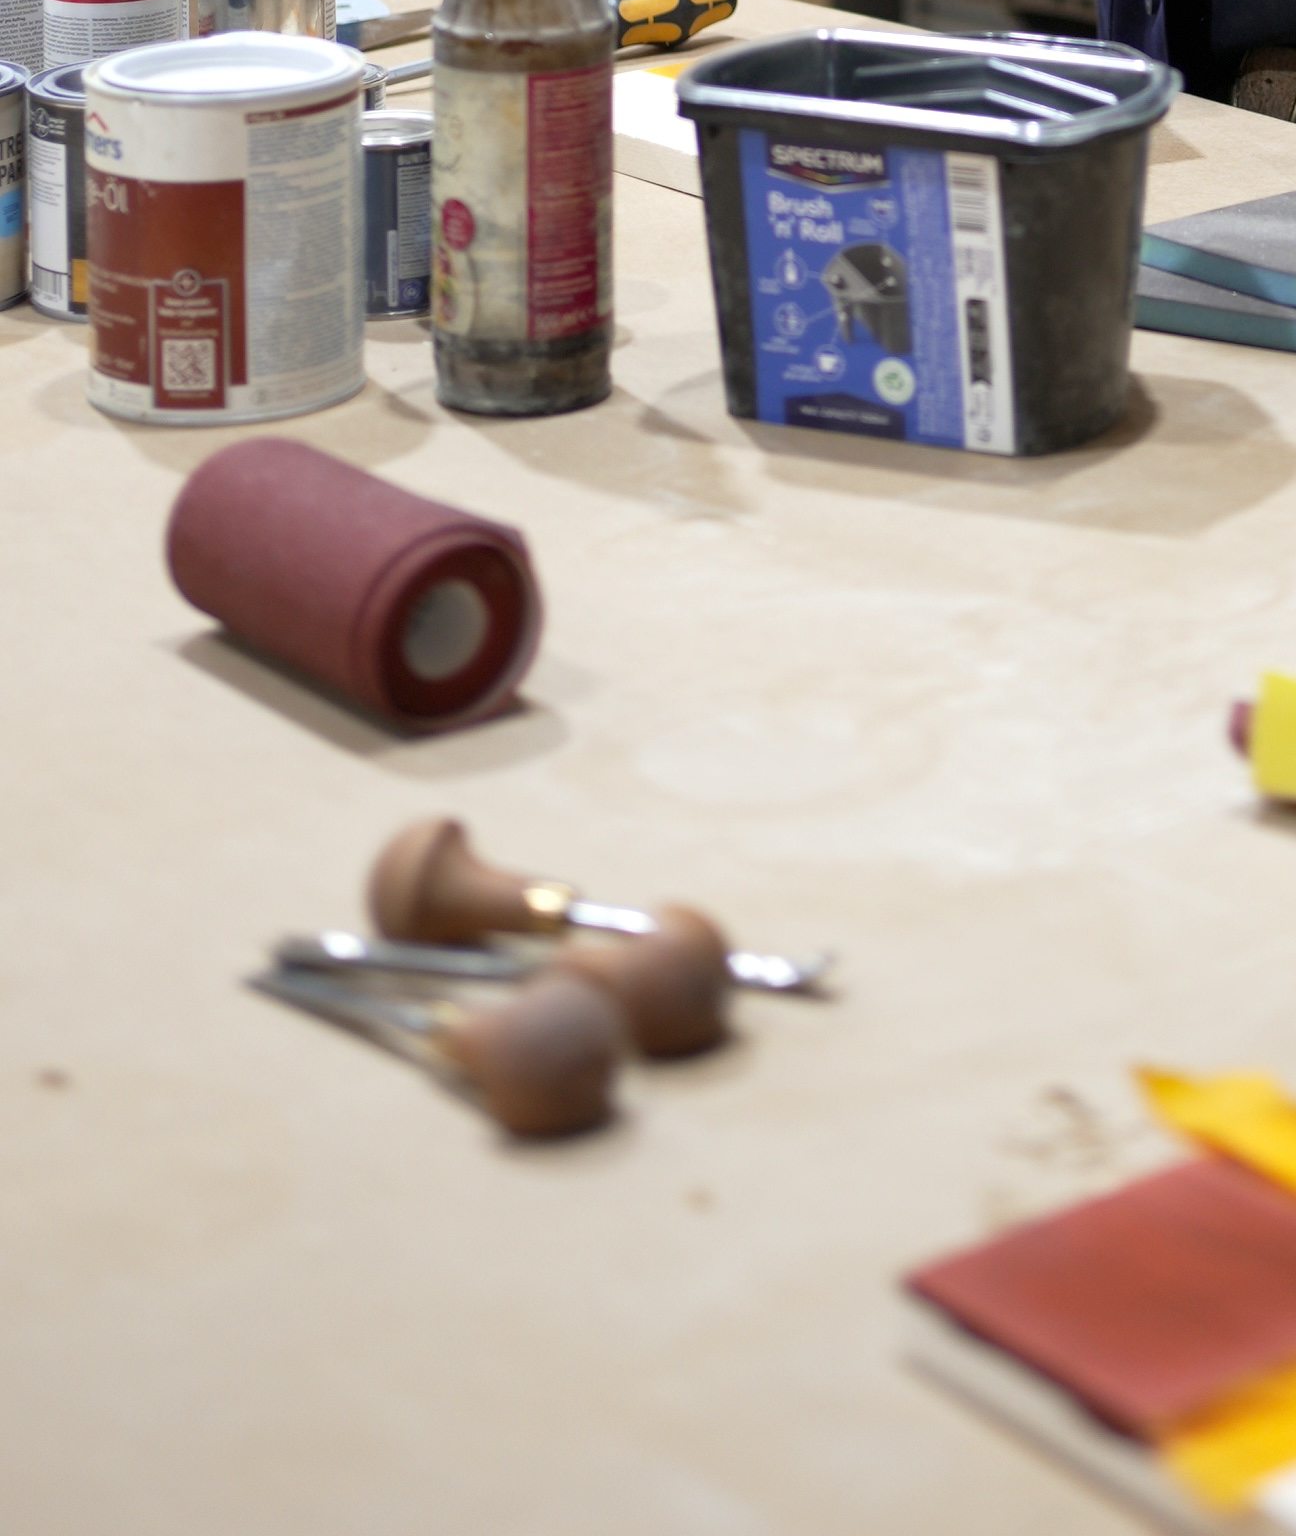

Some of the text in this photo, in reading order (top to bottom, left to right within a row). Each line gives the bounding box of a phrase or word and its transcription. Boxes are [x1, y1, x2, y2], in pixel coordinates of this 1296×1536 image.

[771, 144, 884, 175] SPECTRUM
[768, 190, 834, 219] Brush
[799, 216, 844, 244] Roll
